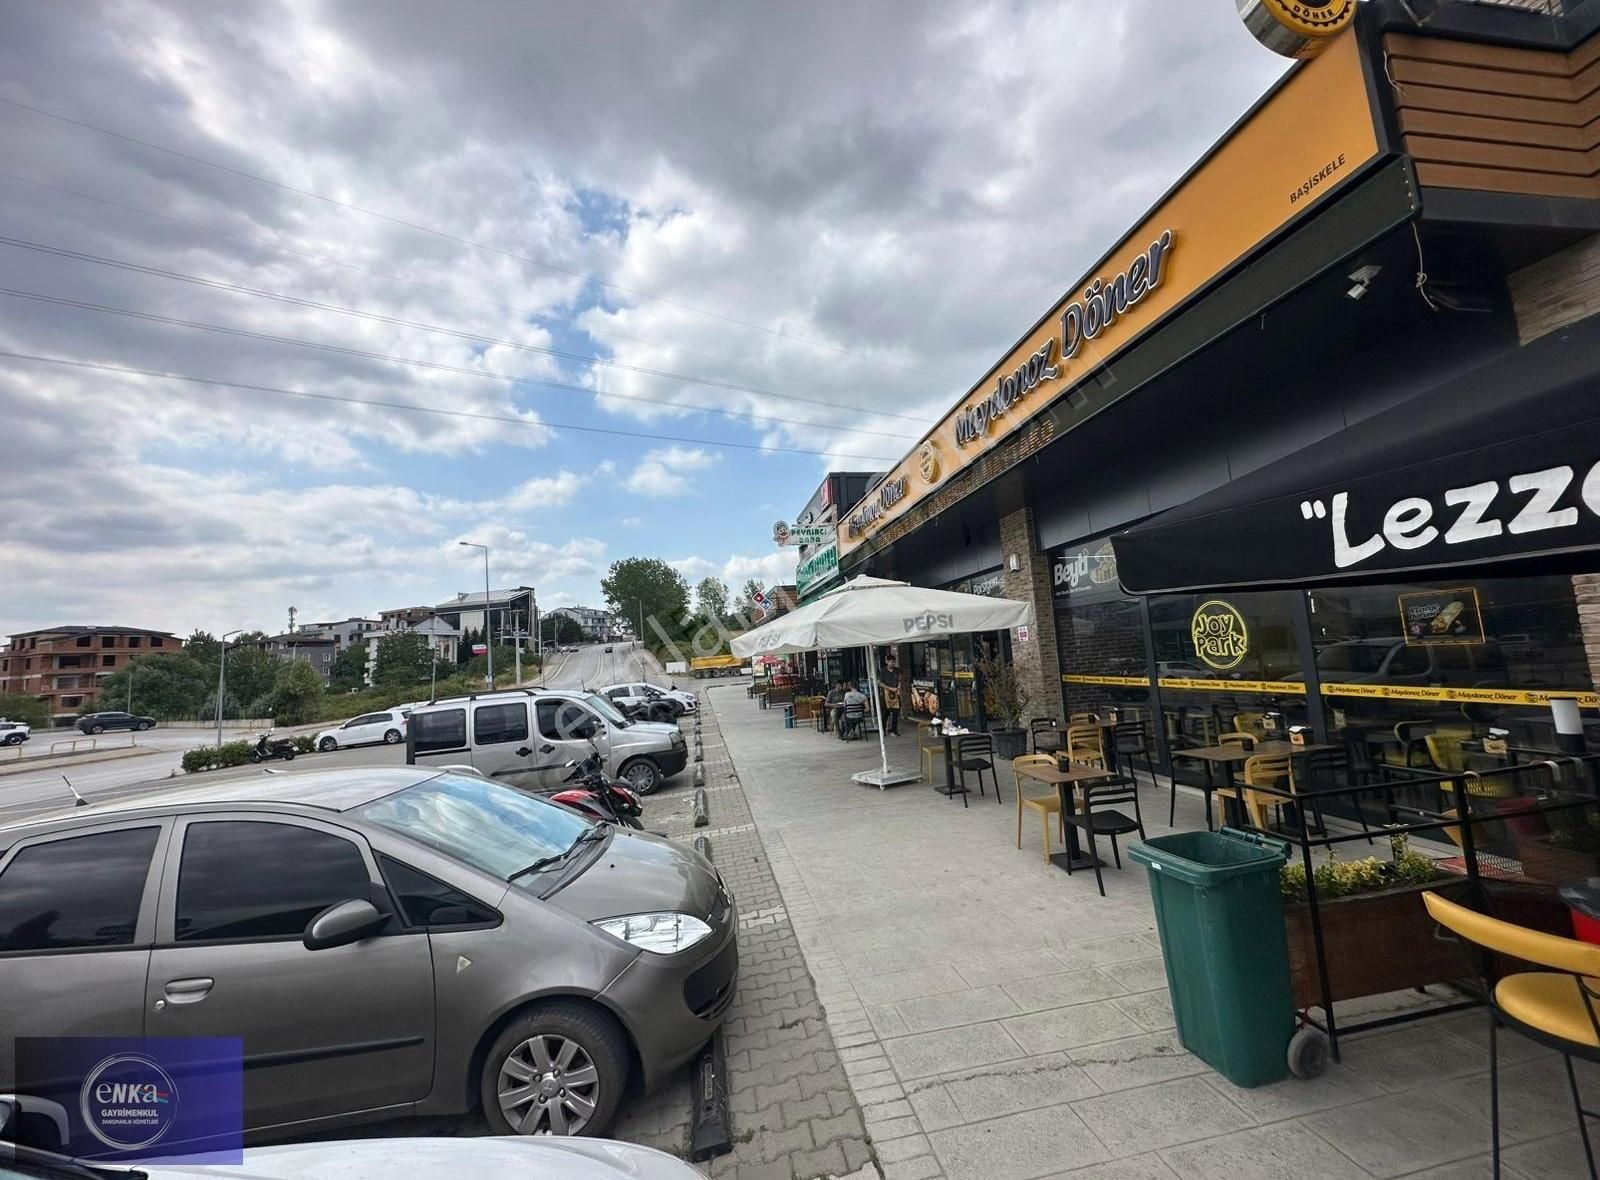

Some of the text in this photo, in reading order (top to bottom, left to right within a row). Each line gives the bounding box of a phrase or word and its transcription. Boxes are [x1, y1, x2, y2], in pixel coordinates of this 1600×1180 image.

[1293, 4, 1335, 20] DÖNER
[1289, 153, 1346, 204] BAŞİSKELE
[954, 229, 1176, 449] Maydonoz Döner
[903, 614, 954, 632] PEPSI
[1195, 613, 1234, 637] Joy
[1195, 631, 1248, 657] Park
[1457, 691, 1494, 700] Maydonoz
